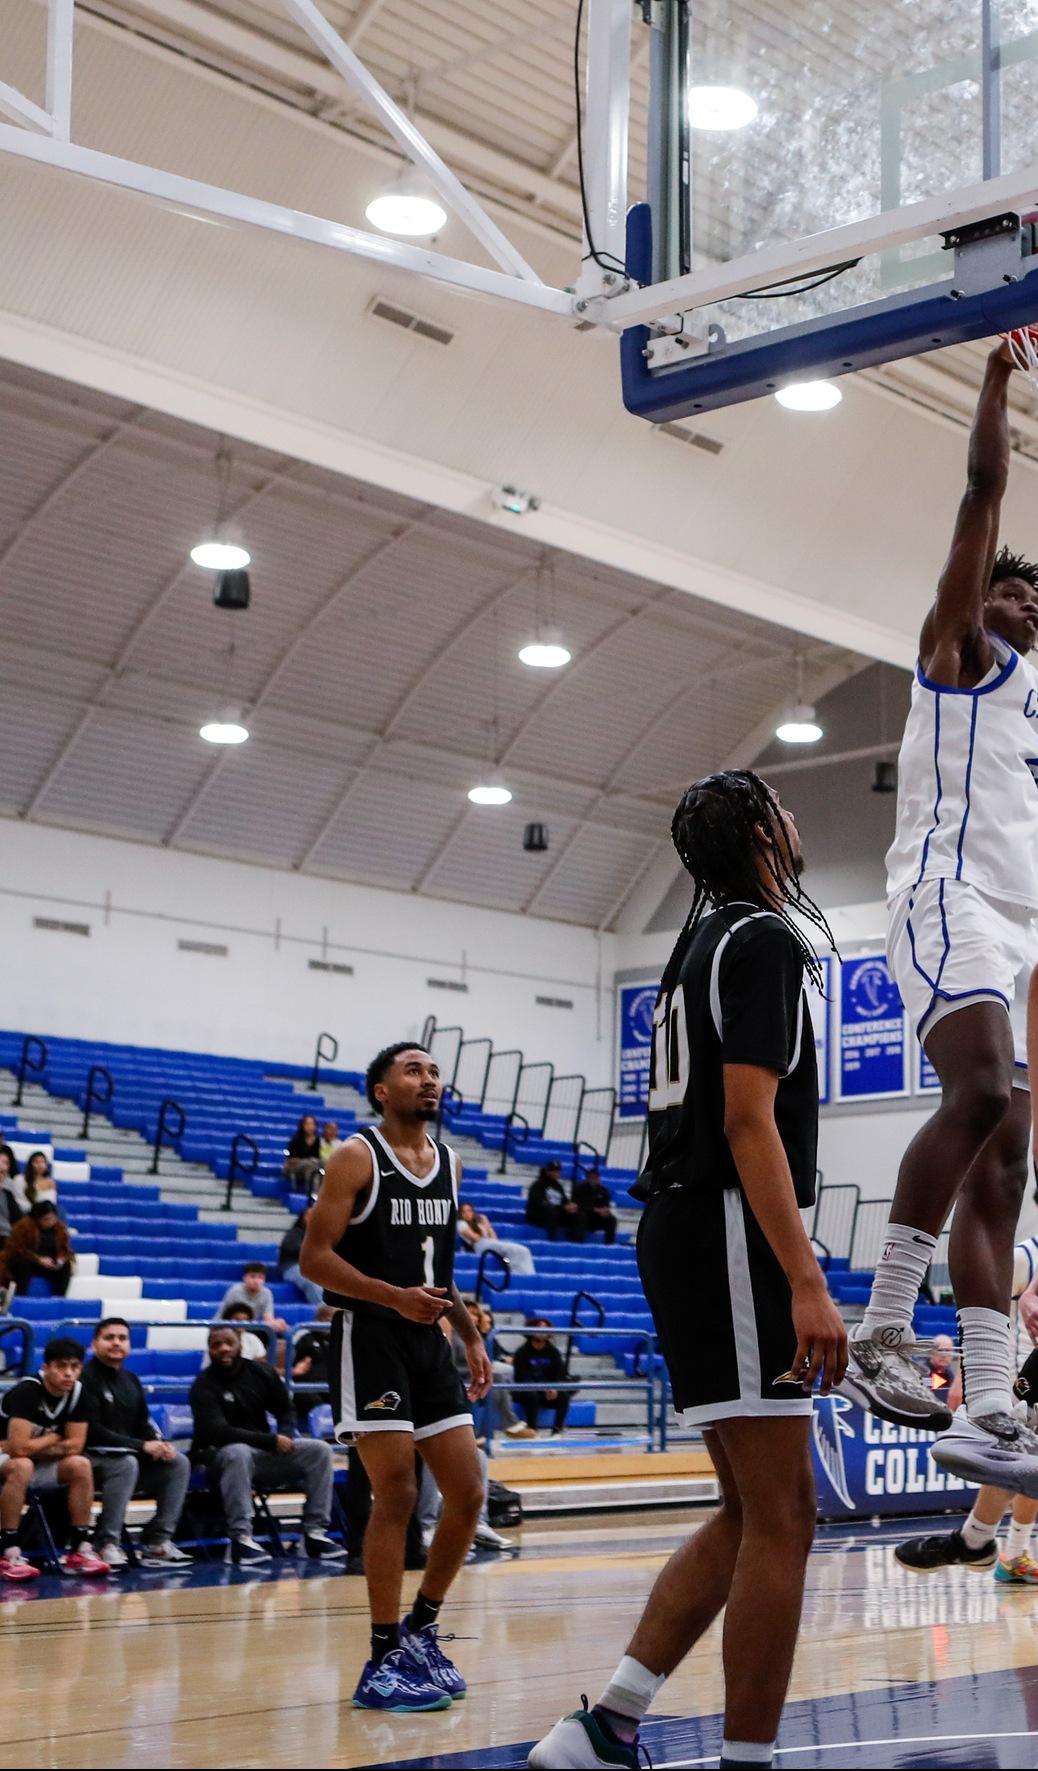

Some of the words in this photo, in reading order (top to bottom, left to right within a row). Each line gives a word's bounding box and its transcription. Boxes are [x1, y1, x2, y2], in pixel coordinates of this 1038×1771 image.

[843, 1031, 902, 1049] CHAMPIONS
[390, 1198, 412, 1226] RIO
[420, 1235, 435, 1288] 1
